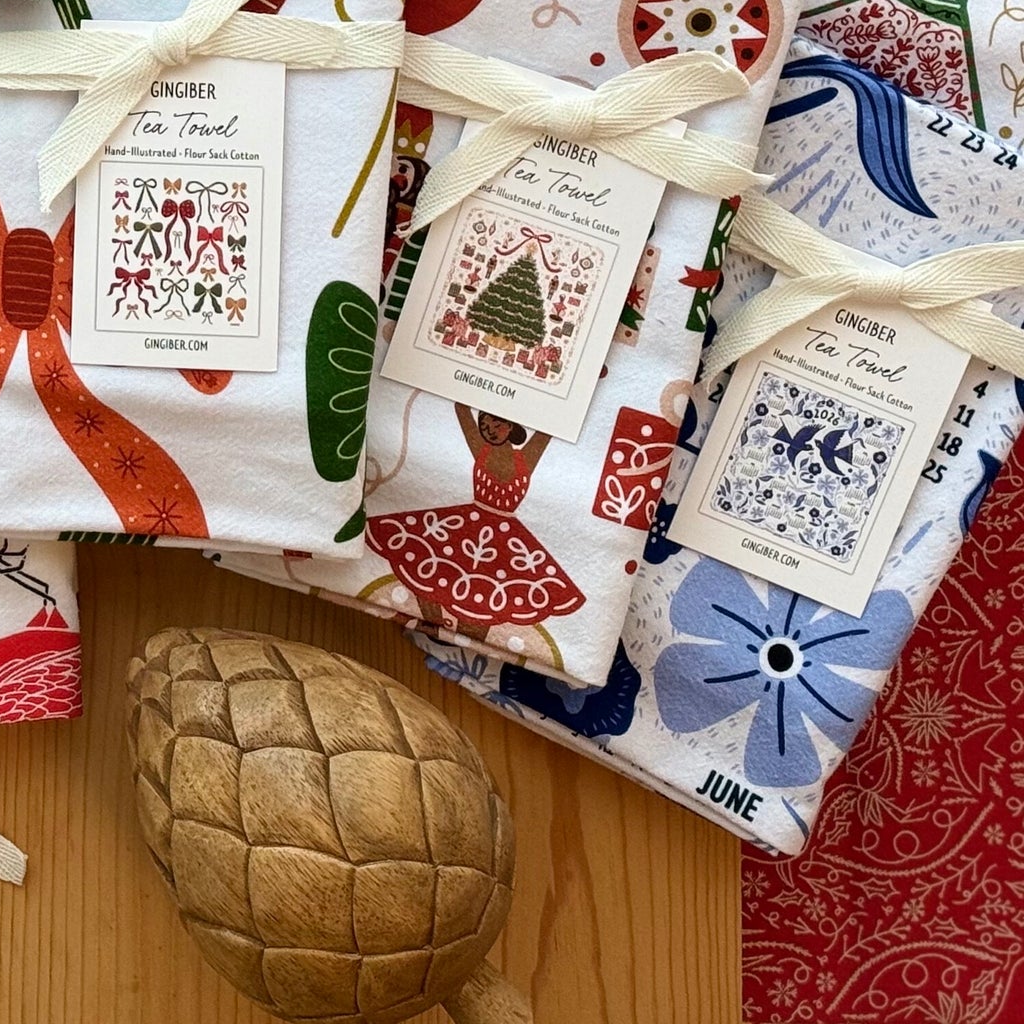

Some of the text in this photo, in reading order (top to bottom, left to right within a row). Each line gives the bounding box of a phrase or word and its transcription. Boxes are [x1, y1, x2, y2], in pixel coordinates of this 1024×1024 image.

[151, 81, 216, 100] GINGIBER
[128, 110, 238, 138] Tea Towel
[105, 145, 259, 160] Hand-Illustrated Flour Sack Cotton
[927, 113, 1017, 170] 22 23 24
[504, 156, 611, 207] Tea Towel
[547, 204, 570, 219] Flour
[571, 211, 591, 227] Sack
[592, 219, 620, 237] Cotton
[835, 309, 897, 345] GINGIBER
[145, 338, 208, 351] GINGIBER.COM
[806, 326, 906, 383] Tea Towel
[454, 369, 517, 400] GINGIBER.COM
[773, 349, 913, 412] Hand-Illustrated Flour Sack Cotton
[973, 381, 989, 399] 4
[813, 409, 841, 426] 2026
[953, 404, 975, 428] 11
[937, 432, 962, 457] 18
[921, 459, 948, 484] 25
[741, 537, 800, 569] GINGIBER.COM
[696, 769, 764, 822] JUNE
